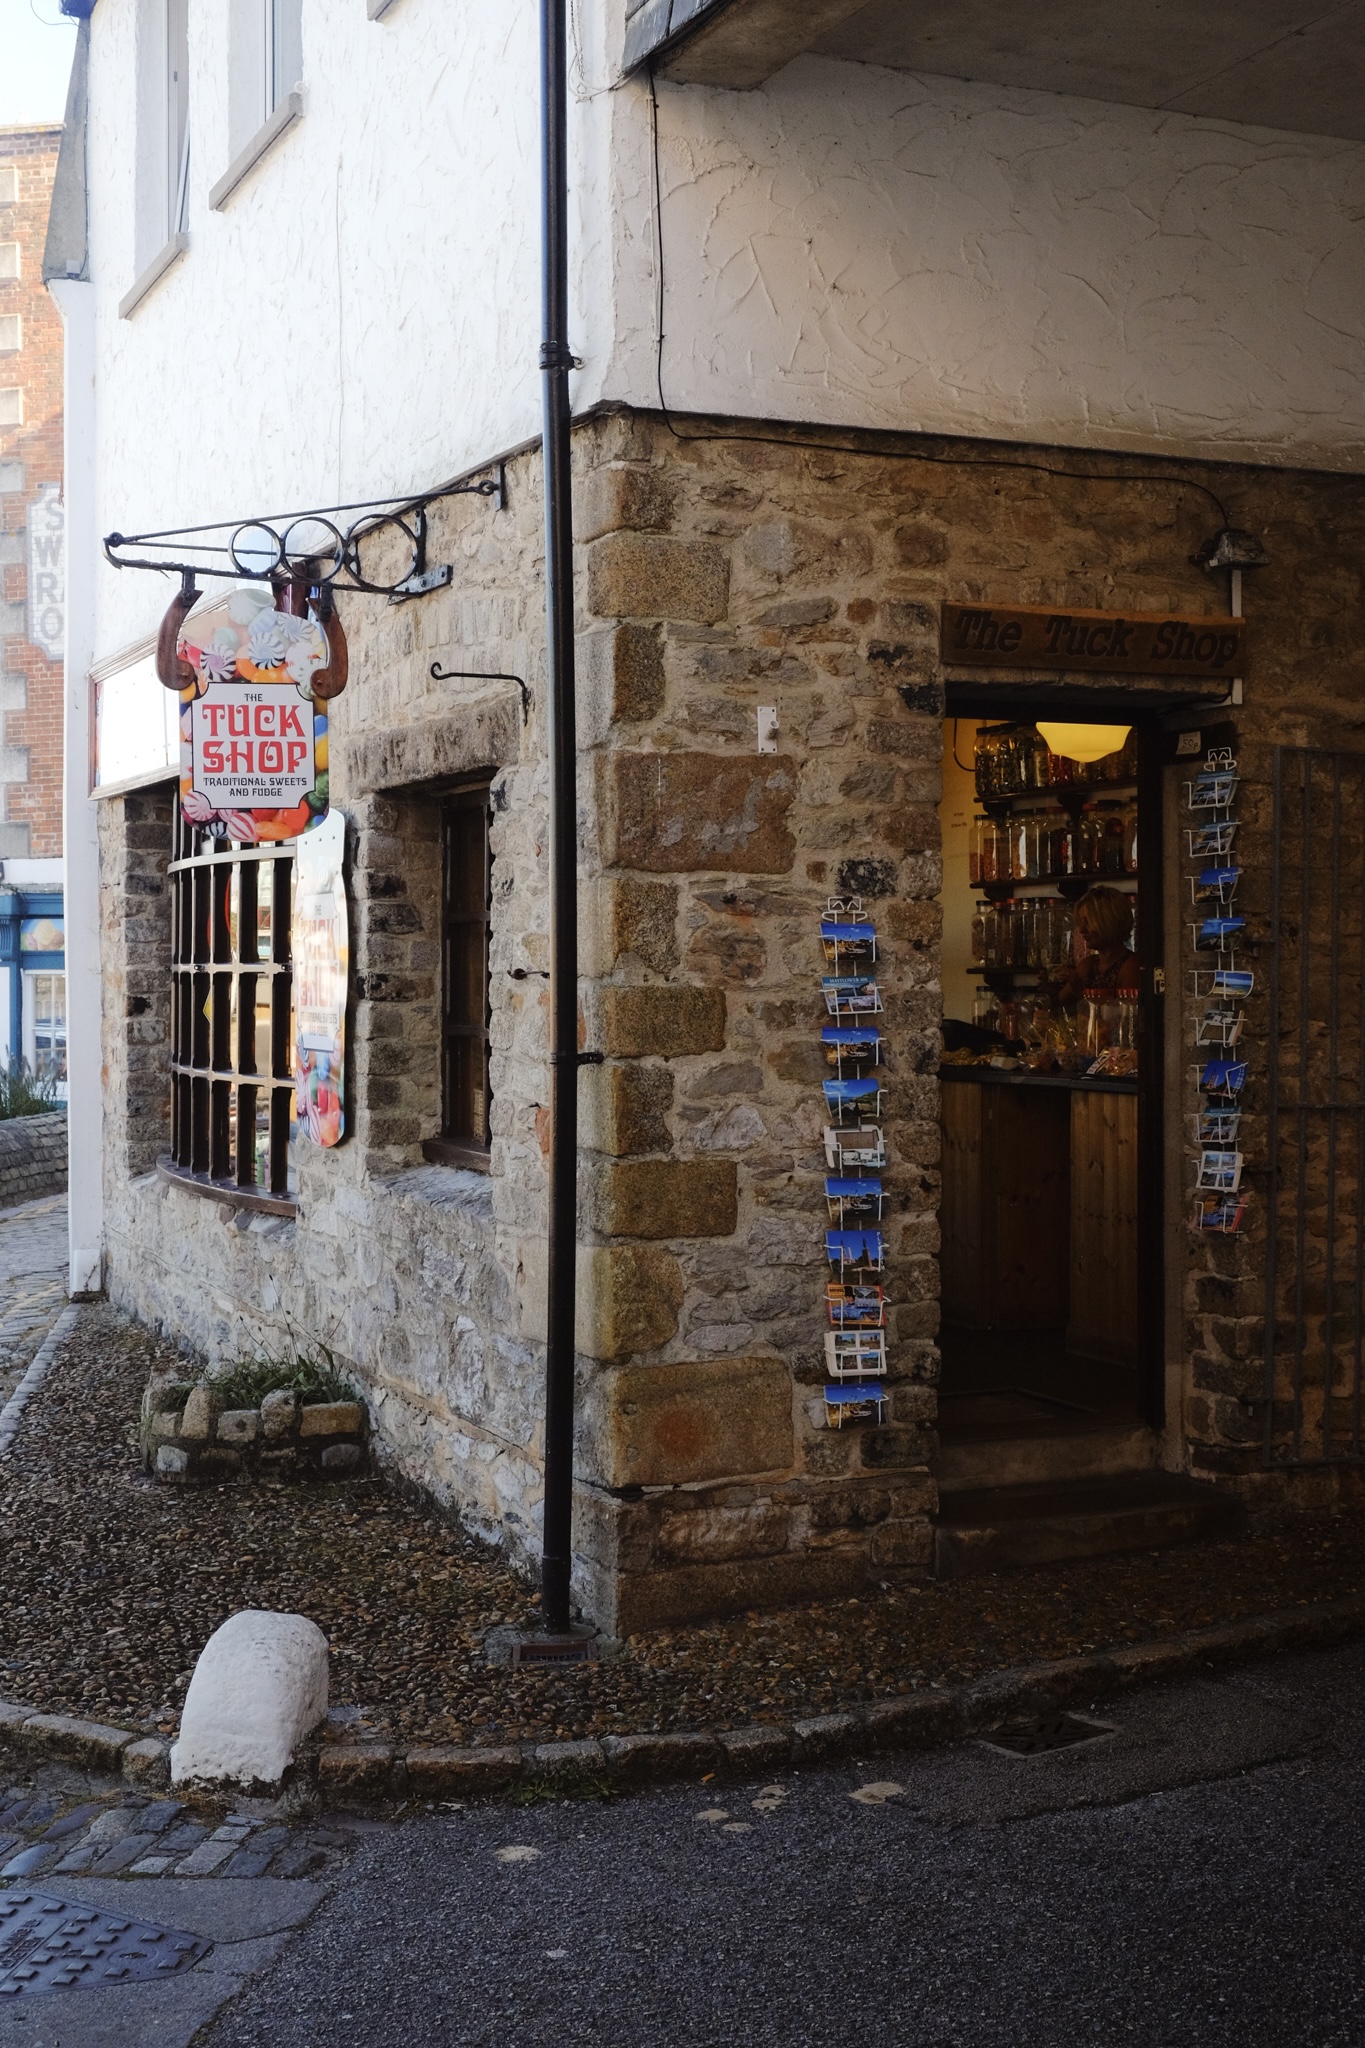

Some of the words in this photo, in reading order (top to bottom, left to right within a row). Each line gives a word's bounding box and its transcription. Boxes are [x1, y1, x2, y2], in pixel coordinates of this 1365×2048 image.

[953, 609, 1023, 653] The
[1045, 614, 1135, 658] Tuck
[1150, 619, 1240, 669] Shop
[244, 693, 263, 702] THE
[202, 704, 306, 737] TUCK
[1183, 738, 1199, 751] 50p
[203, 740, 307, 774] SHOP
[204, 777, 266, 787] TRADITIONAL
[269, 777, 308, 786] SWEETS
[229, 788, 249, 797] AND
[252, 788, 283, 797] FUDGE
